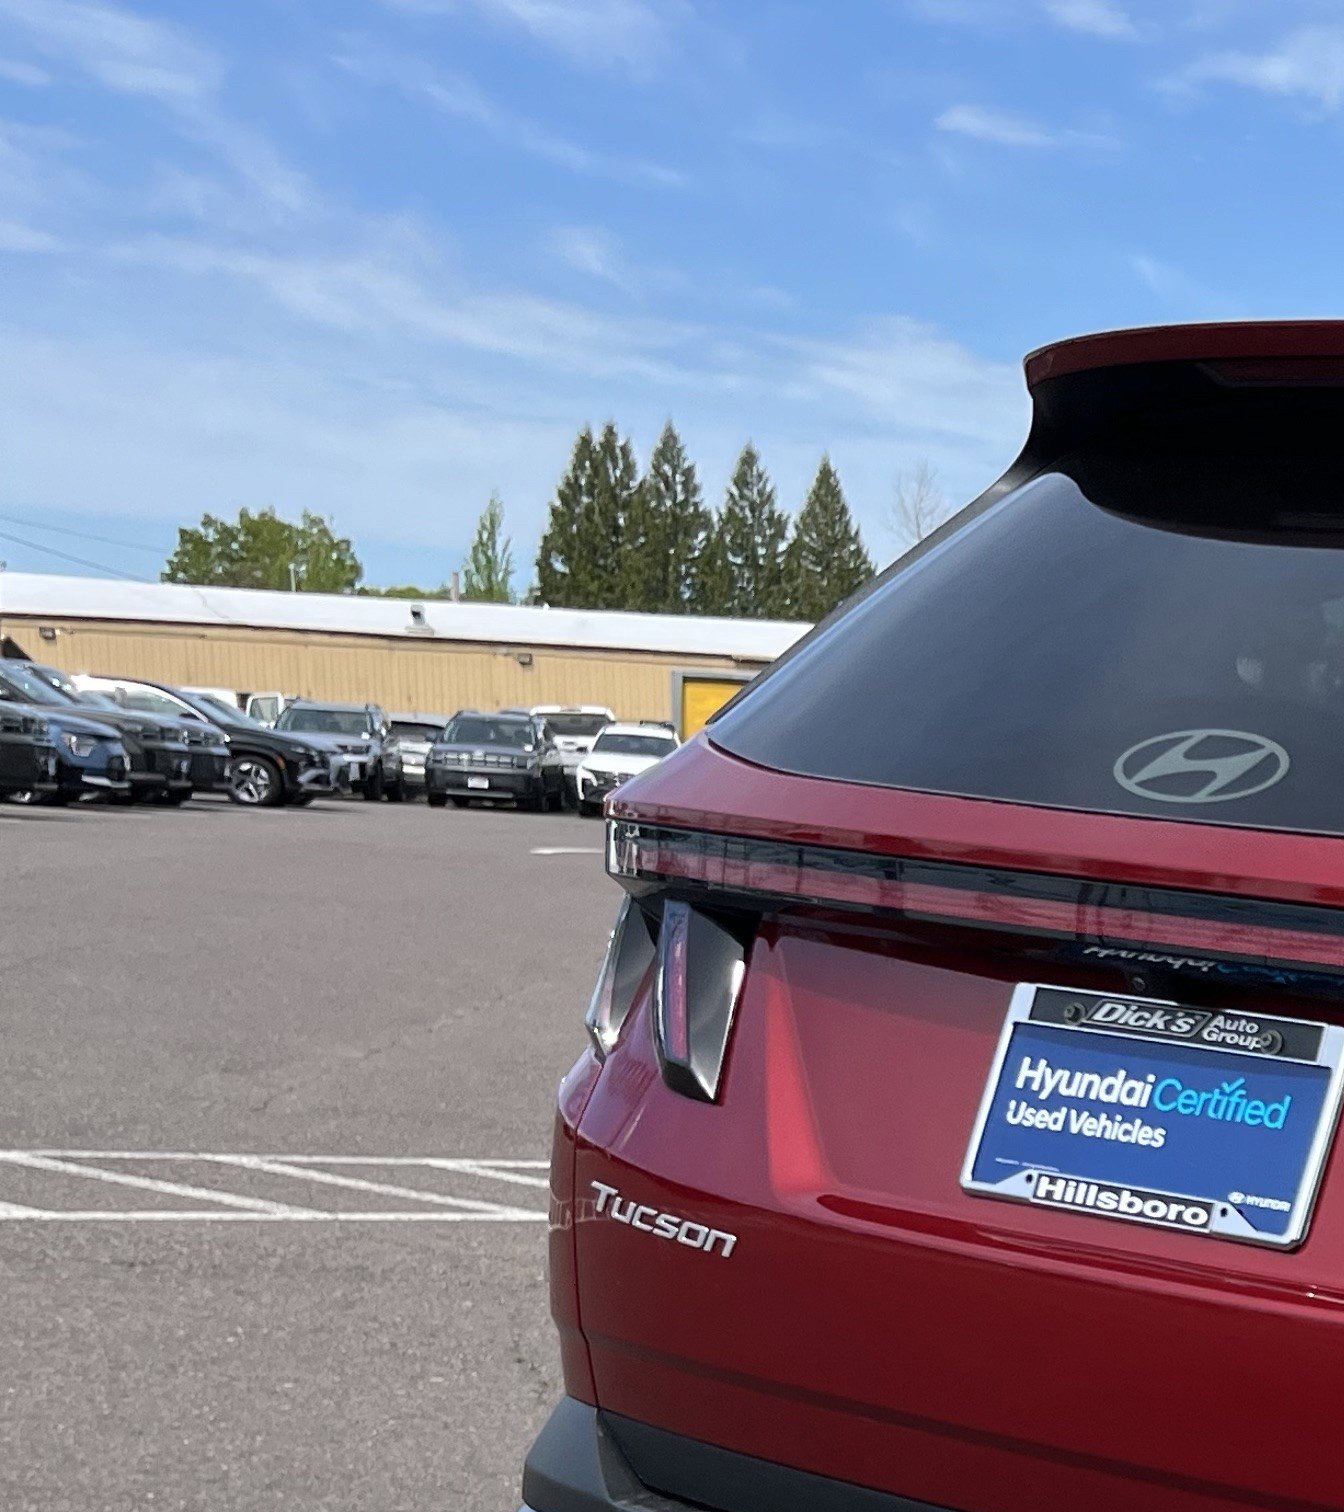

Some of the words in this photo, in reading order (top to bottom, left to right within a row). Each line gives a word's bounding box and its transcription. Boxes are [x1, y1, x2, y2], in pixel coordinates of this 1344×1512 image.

[1092, 1003, 1196, 1033] Dick's
[1202, 1028, 1262, 1049] Group
[1209, 1015, 1259, 1034] Auto
[1015, 1056, 1156, 1108] Hyundai
[1153, 1077, 1292, 1129] Certified
[1006, 1100, 1067, 1131] Used
[1069, 1109, 1167, 1148] Vehicles
[591, 1180, 737, 1258] Tucson
[1036, 1176, 1209, 1225] Hillsboro
